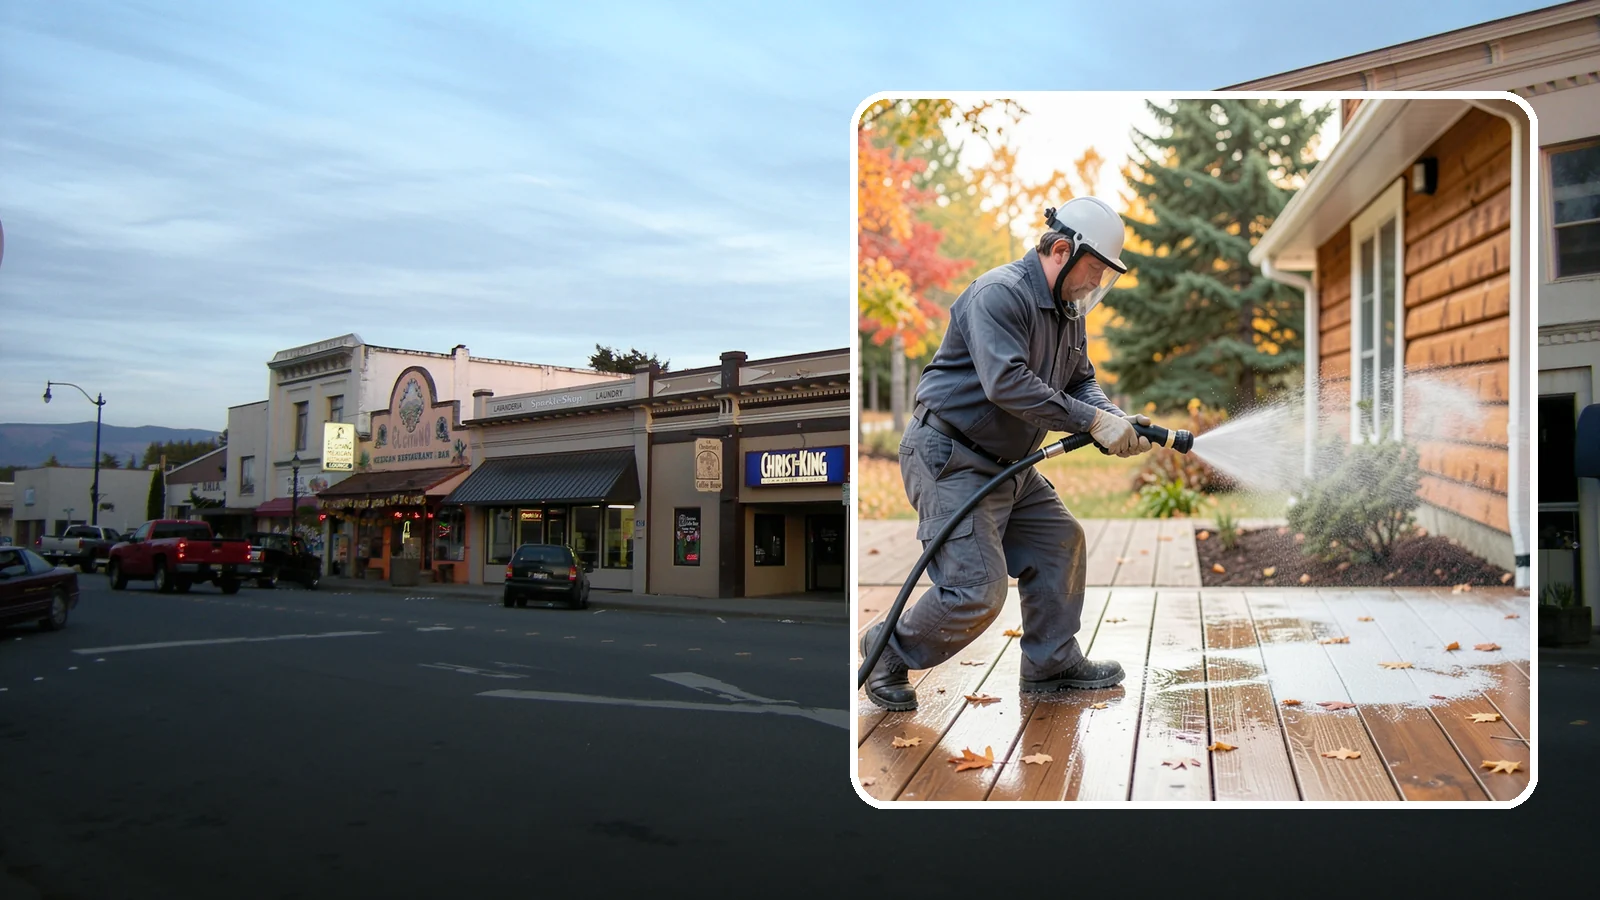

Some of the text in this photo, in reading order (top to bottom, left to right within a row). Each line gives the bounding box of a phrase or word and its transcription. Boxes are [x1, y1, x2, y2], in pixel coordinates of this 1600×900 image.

[595, 389, 624, 400] LAUNDRY
[493, 402, 523, 413] LAVANDERIA
[373, 454, 396, 464] MEXICAN
[397, 452, 433, 462] RESTAURANT
[438, 450, 450, 459] BAR
[799, 450, 827, 476] KING
